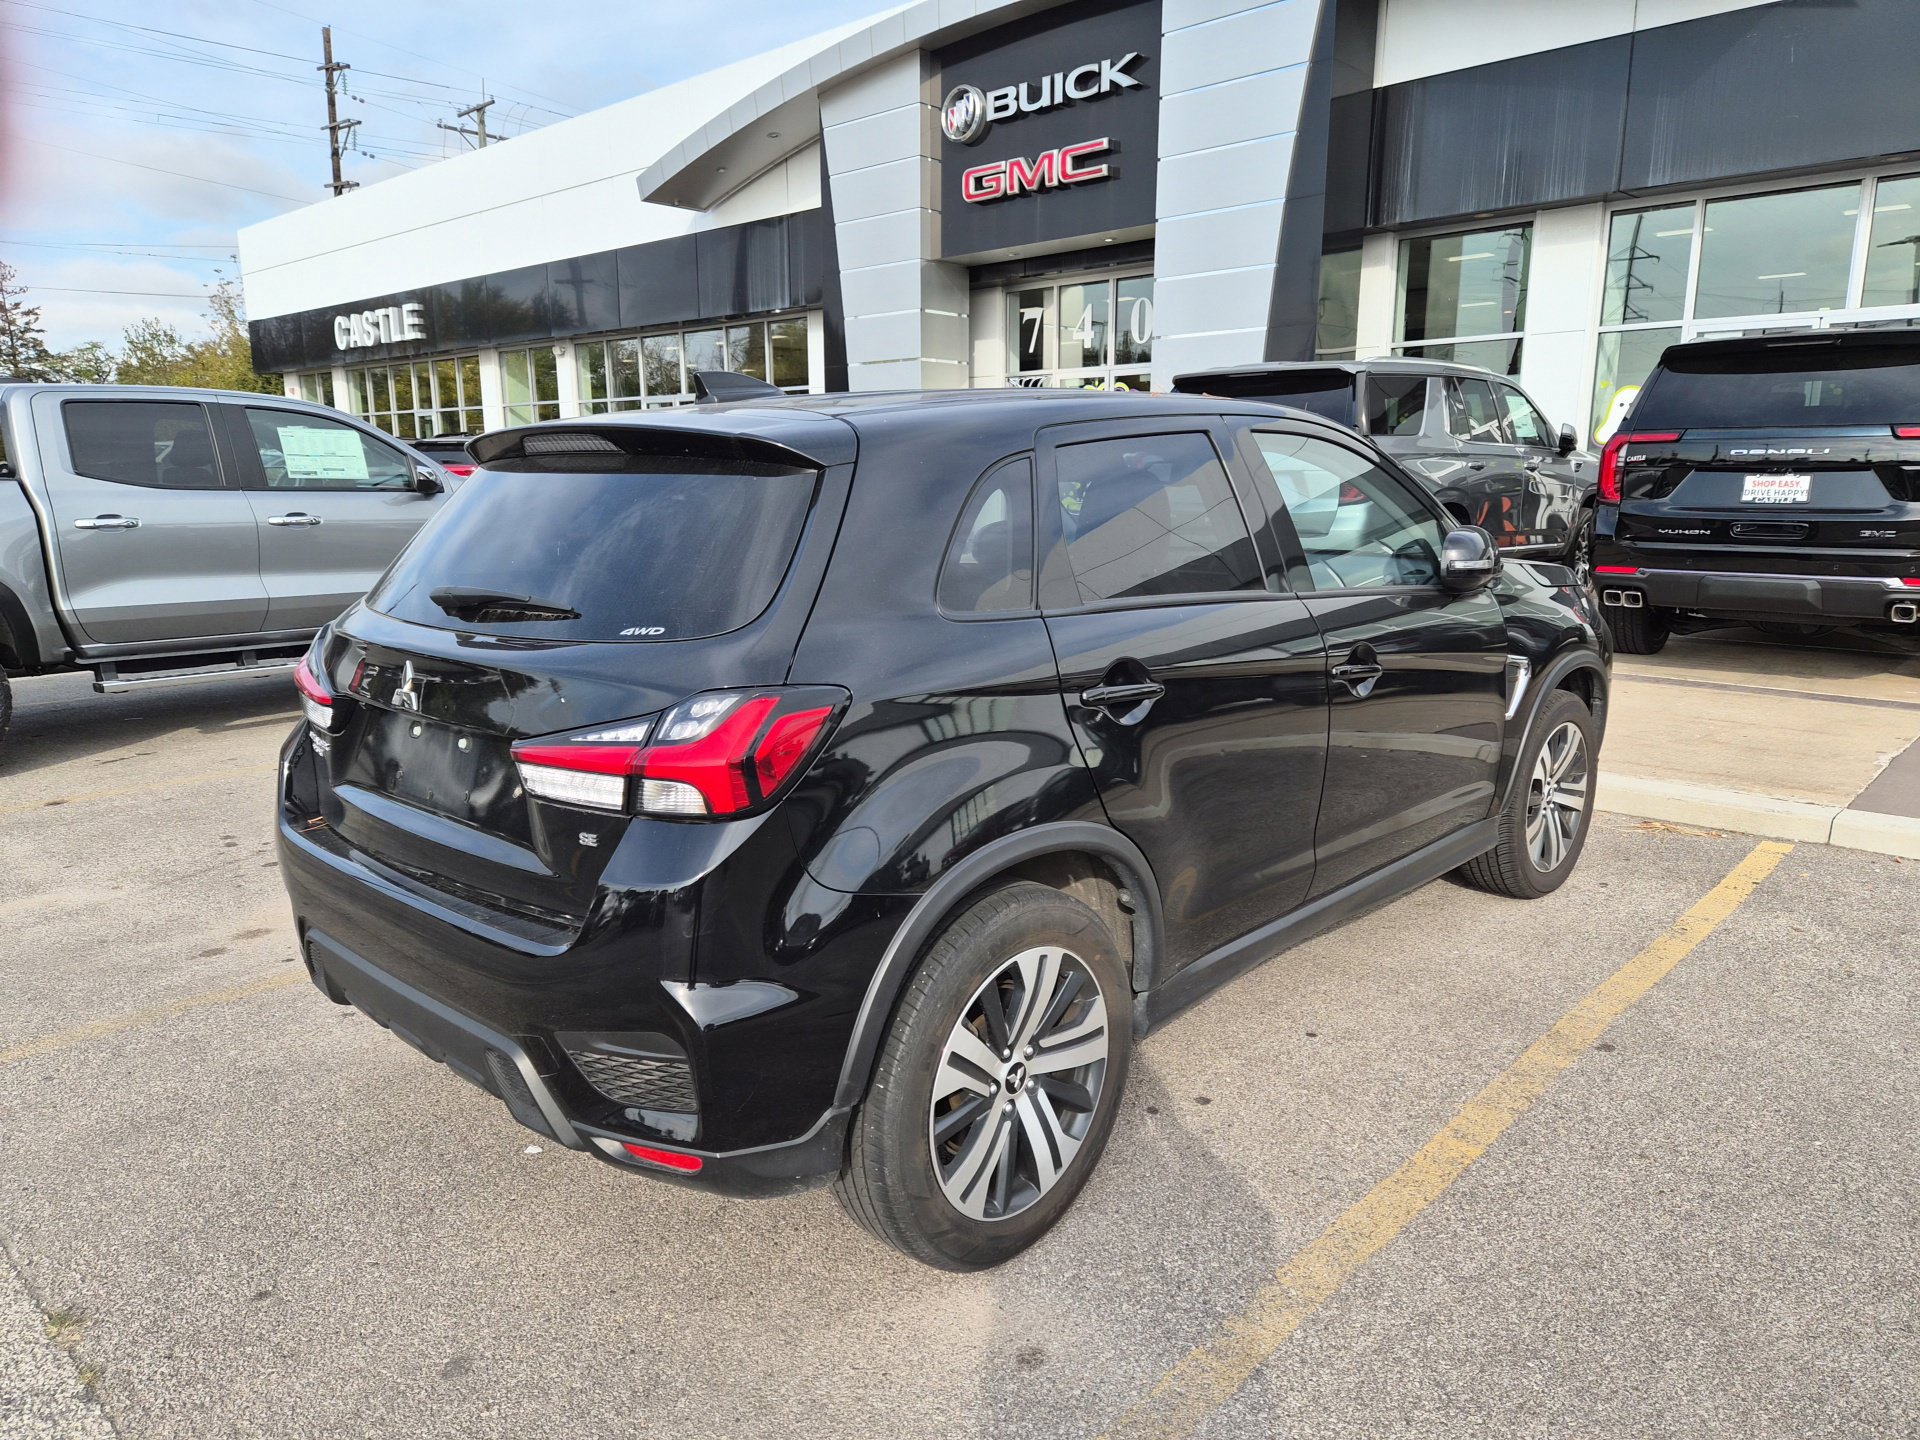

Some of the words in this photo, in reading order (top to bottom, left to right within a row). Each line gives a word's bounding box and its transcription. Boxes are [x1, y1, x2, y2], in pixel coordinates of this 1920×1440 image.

[986, 51, 1144, 122] BUICK
[962, 136, 1110, 203] GMC
[333, 302, 427, 350] CASTLE
[1730, 448, 1830, 456] DENALI
[1626, 455, 1647, 463] CASTLE
[1751, 480, 1777, 488] SHOP
[1773, 489, 1809, 497] HAPPY!
[1859, 530, 1897, 538] GMC
[619, 626, 666, 636] 4WD
[578, 831, 599, 848] SE
